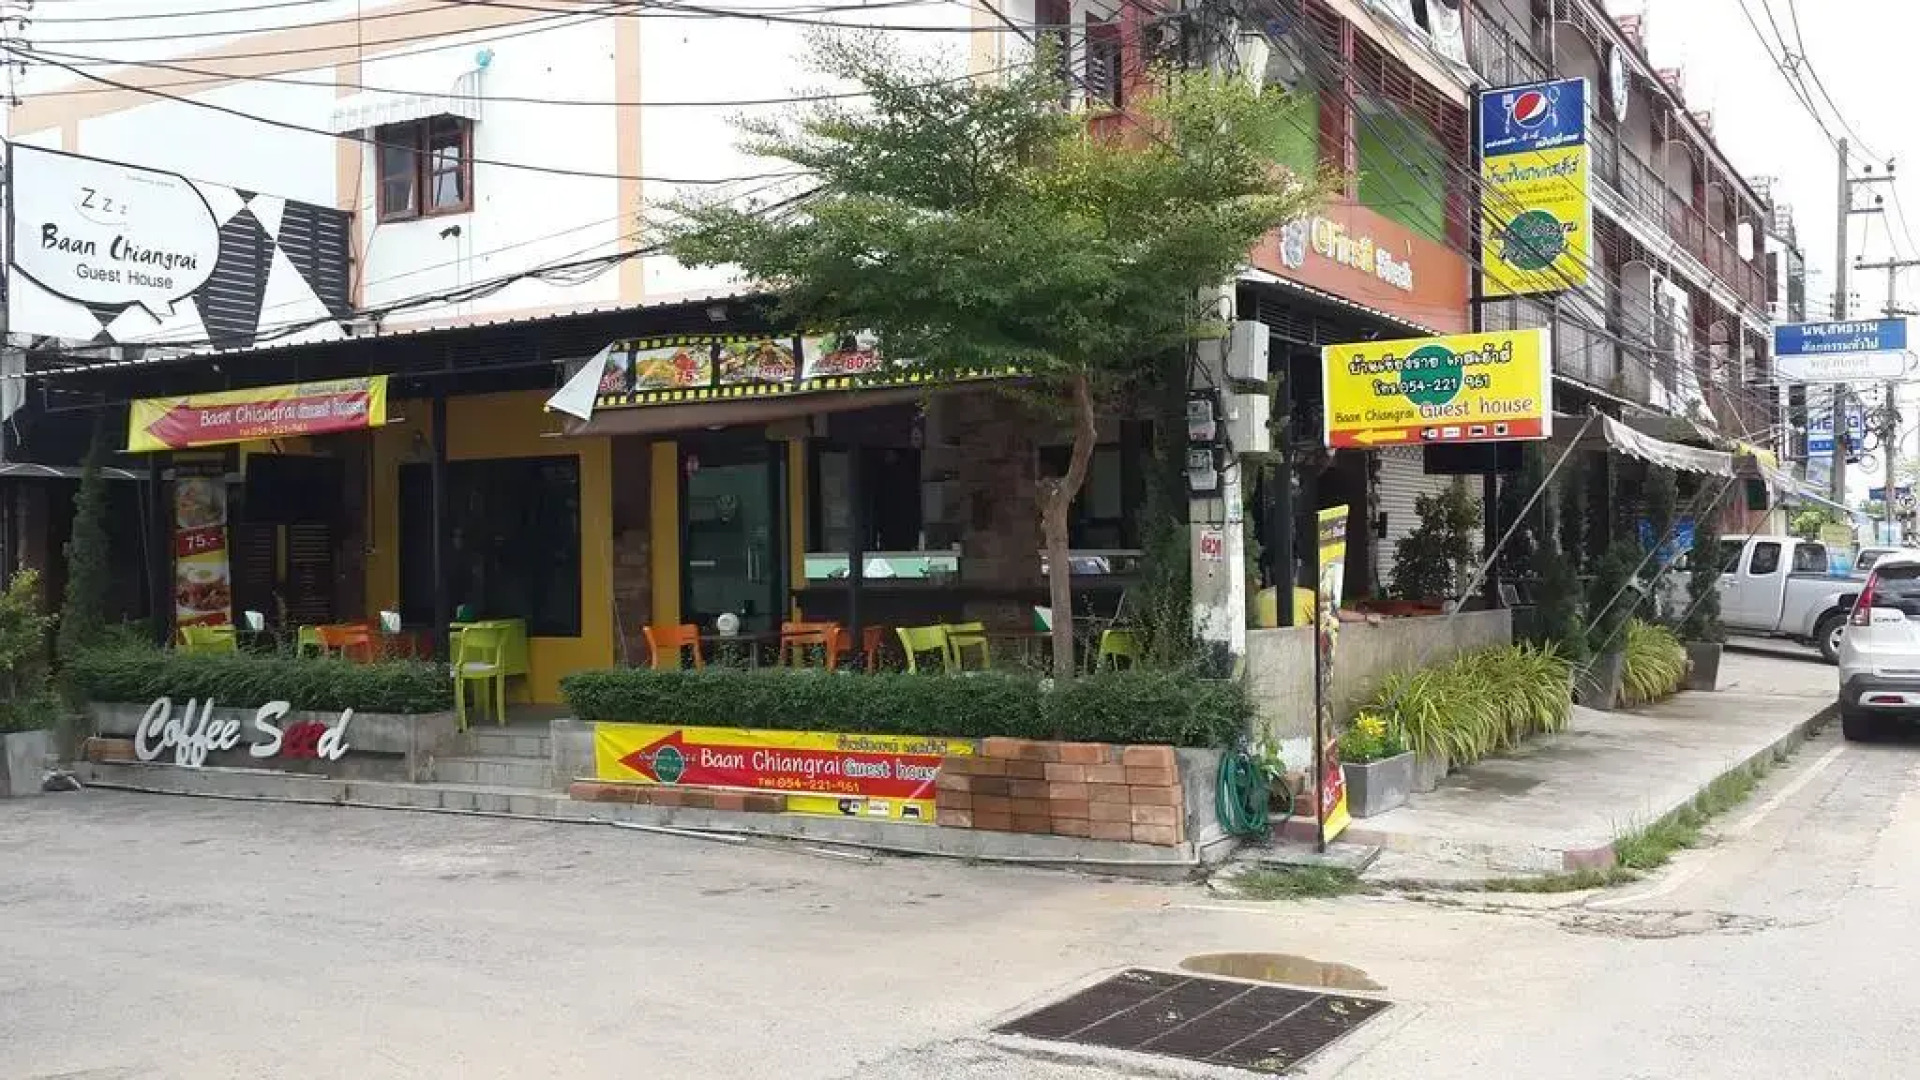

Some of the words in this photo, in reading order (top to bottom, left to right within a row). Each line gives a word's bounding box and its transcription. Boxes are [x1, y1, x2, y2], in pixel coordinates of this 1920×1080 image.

[41, 222, 96, 256] Baan
[110, 234, 197, 270] Chiangrai
[76, 263, 120, 283] Guest
[128, 270, 173, 289] House
[1465, 373, 1490, 390] 961
[201, 408, 231, 427] Baan
[235, 402, 295, 425] Chiangrai
[1335, 411, 1361, 424] Baan
[1364, 408, 1415, 423] Chiangrai
[1419, 400, 1471, 419] Guest
[1480, 396, 1533, 414] house
[1808, 416, 1860, 430] HEG
[135, 697, 240, 767] Coffee
[700, 747, 744, 769] Baan
[752, 749, 841, 779] Chiangrai
[843, 757, 892, 779] Guest
